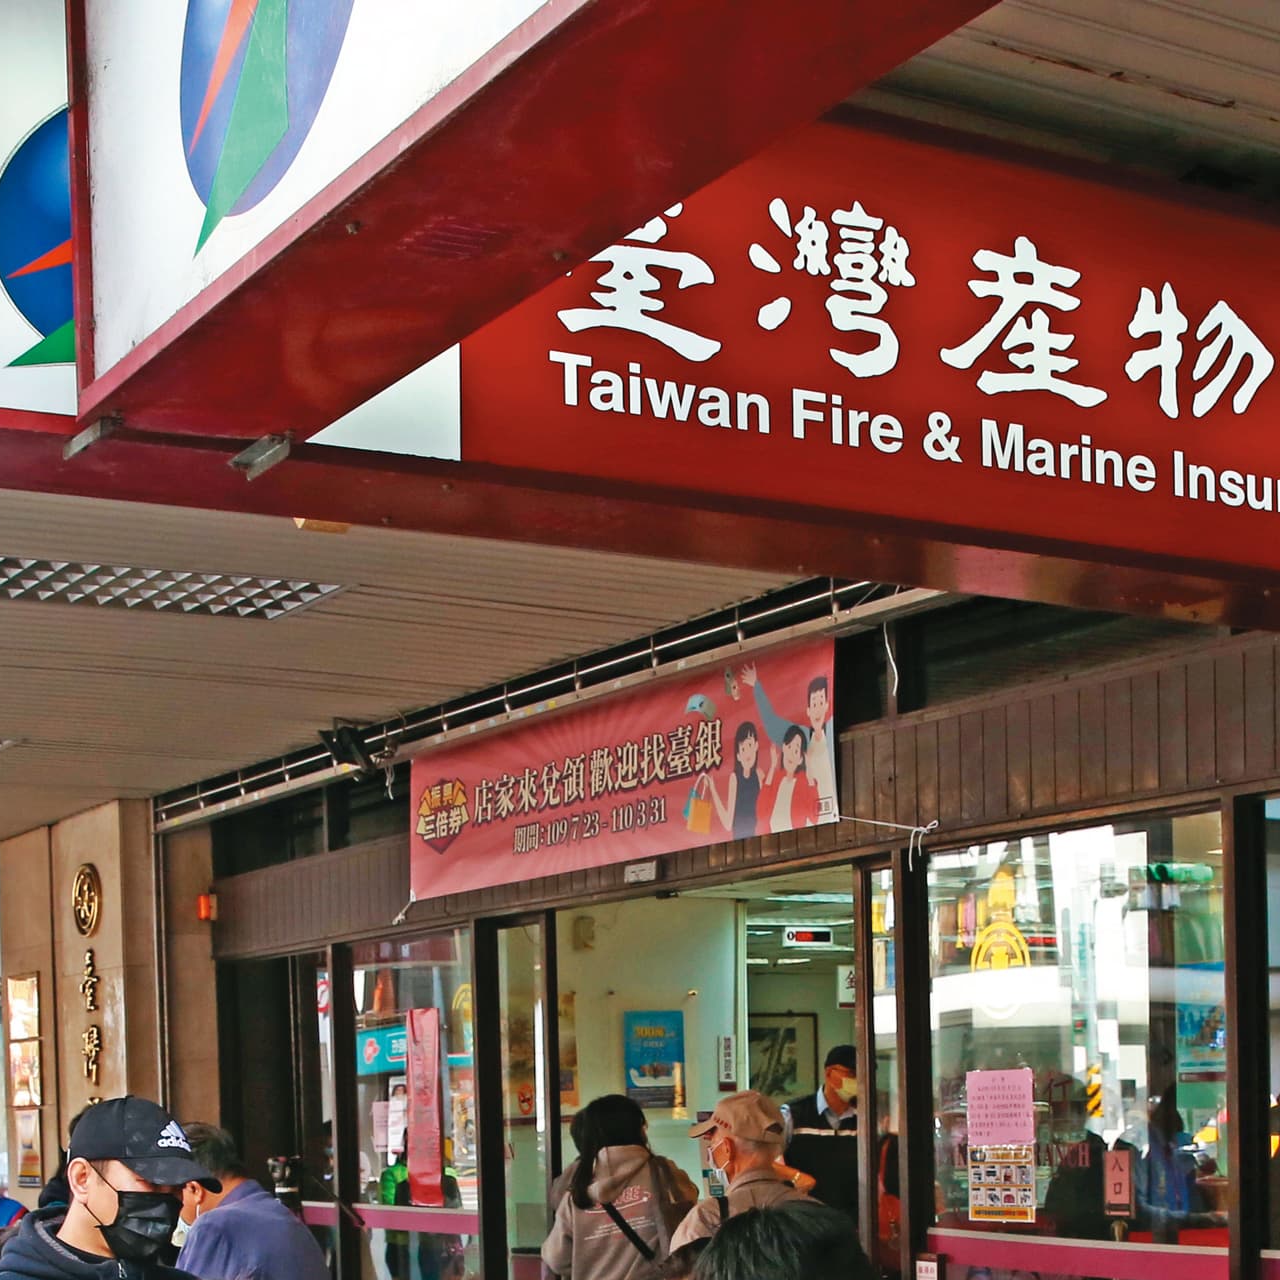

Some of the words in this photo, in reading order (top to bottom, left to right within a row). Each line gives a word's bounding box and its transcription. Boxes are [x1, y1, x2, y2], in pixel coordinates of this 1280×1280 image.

[548, 349, 772, 435] Taiwan
[790, 388, 904, 454] Fire
[922, 411, 961, 461] &
[980, 417, 1157, 491] Marine
[590, 719, 723, 797] 歡迎找臺銀
